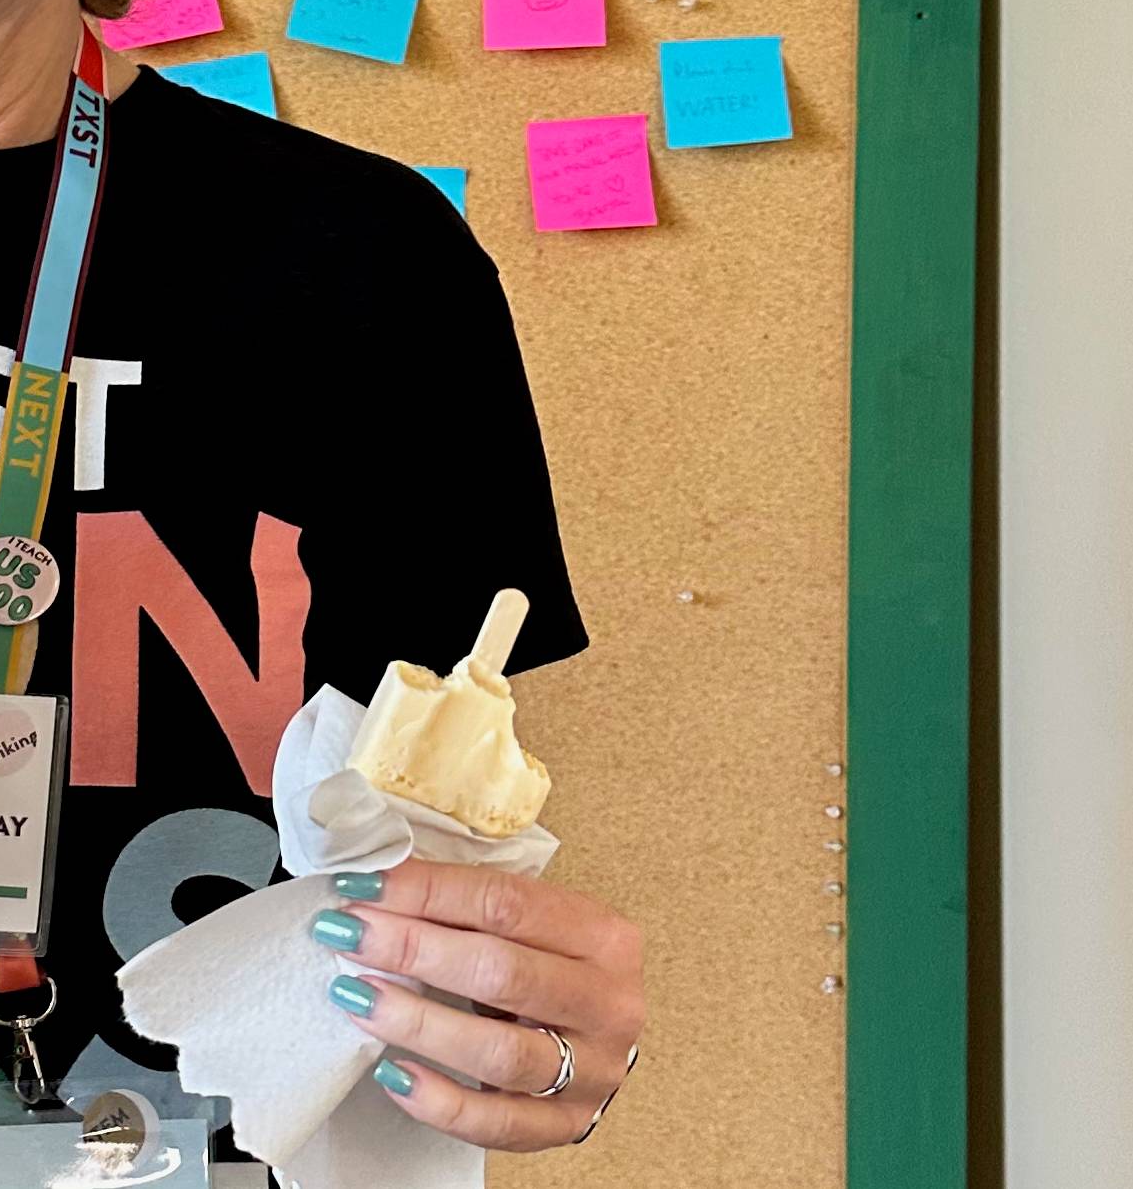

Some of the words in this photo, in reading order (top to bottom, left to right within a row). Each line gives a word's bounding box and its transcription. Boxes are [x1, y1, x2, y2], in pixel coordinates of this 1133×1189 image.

[70, 91, 99, 168] TXST
[10, 372, 53, 478] NEXT
[8, 536, 16, 545] I
[15, 539, 52, 566] TEACH
